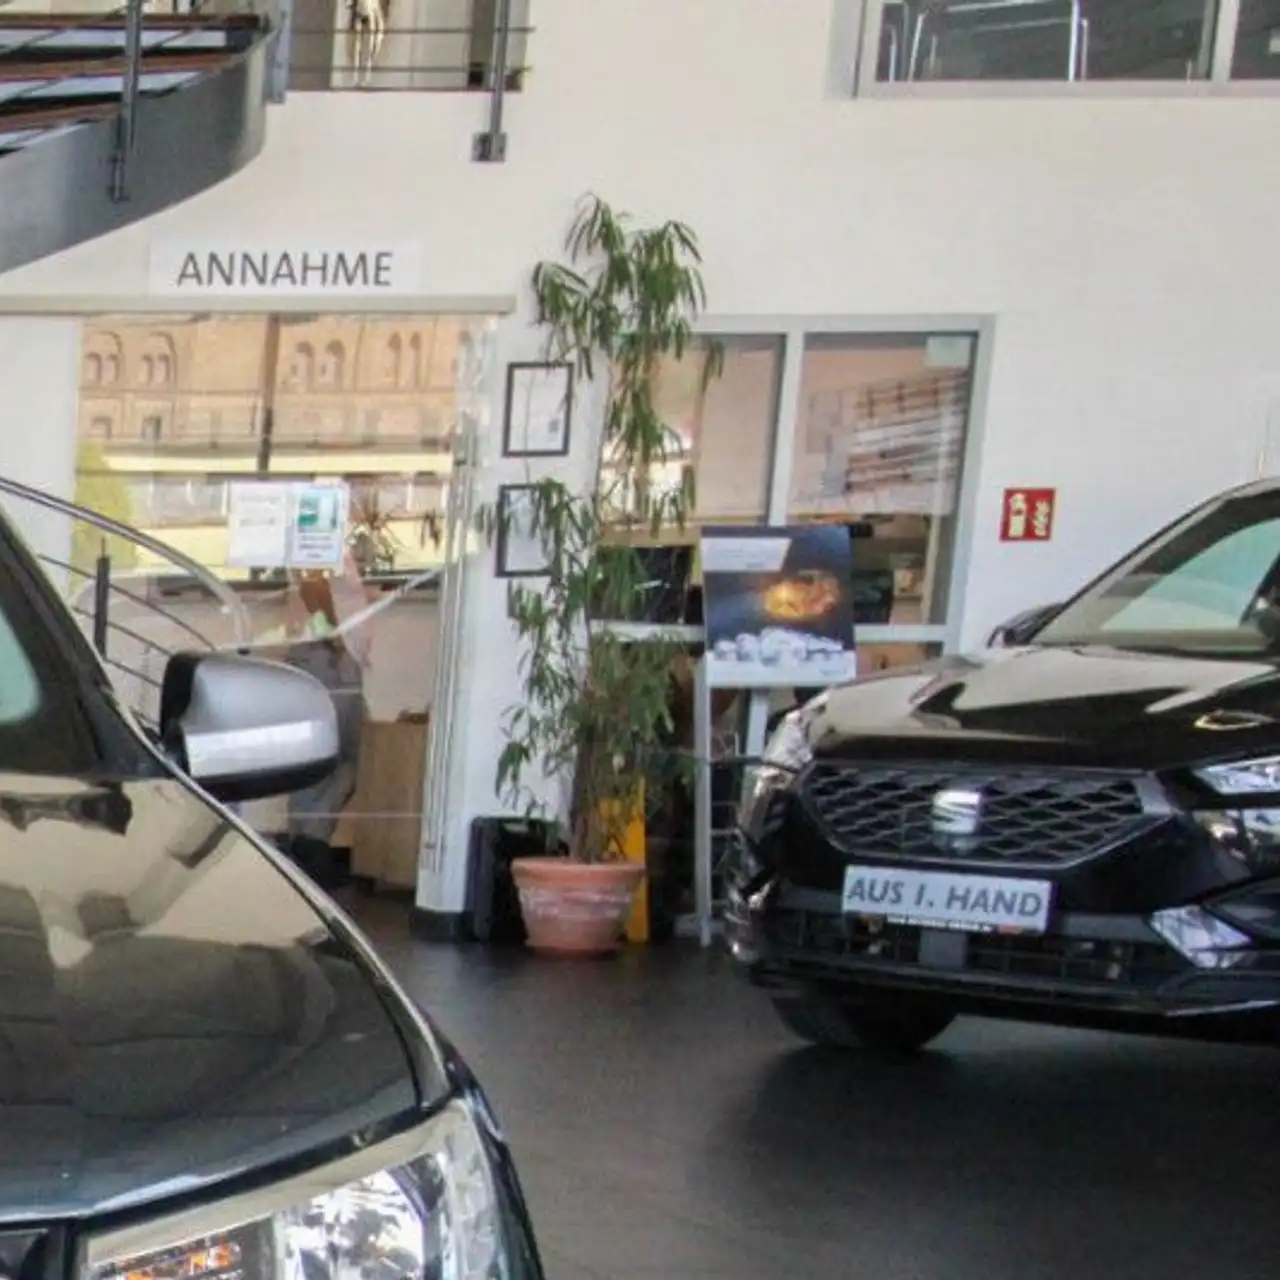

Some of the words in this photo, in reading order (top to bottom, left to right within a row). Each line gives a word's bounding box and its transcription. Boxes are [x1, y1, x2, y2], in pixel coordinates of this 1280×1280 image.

[176, 250, 393, 287] ANNAHME
[848, 876, 905, 905] AUS
[945, 884, 1040, 916] HAND
